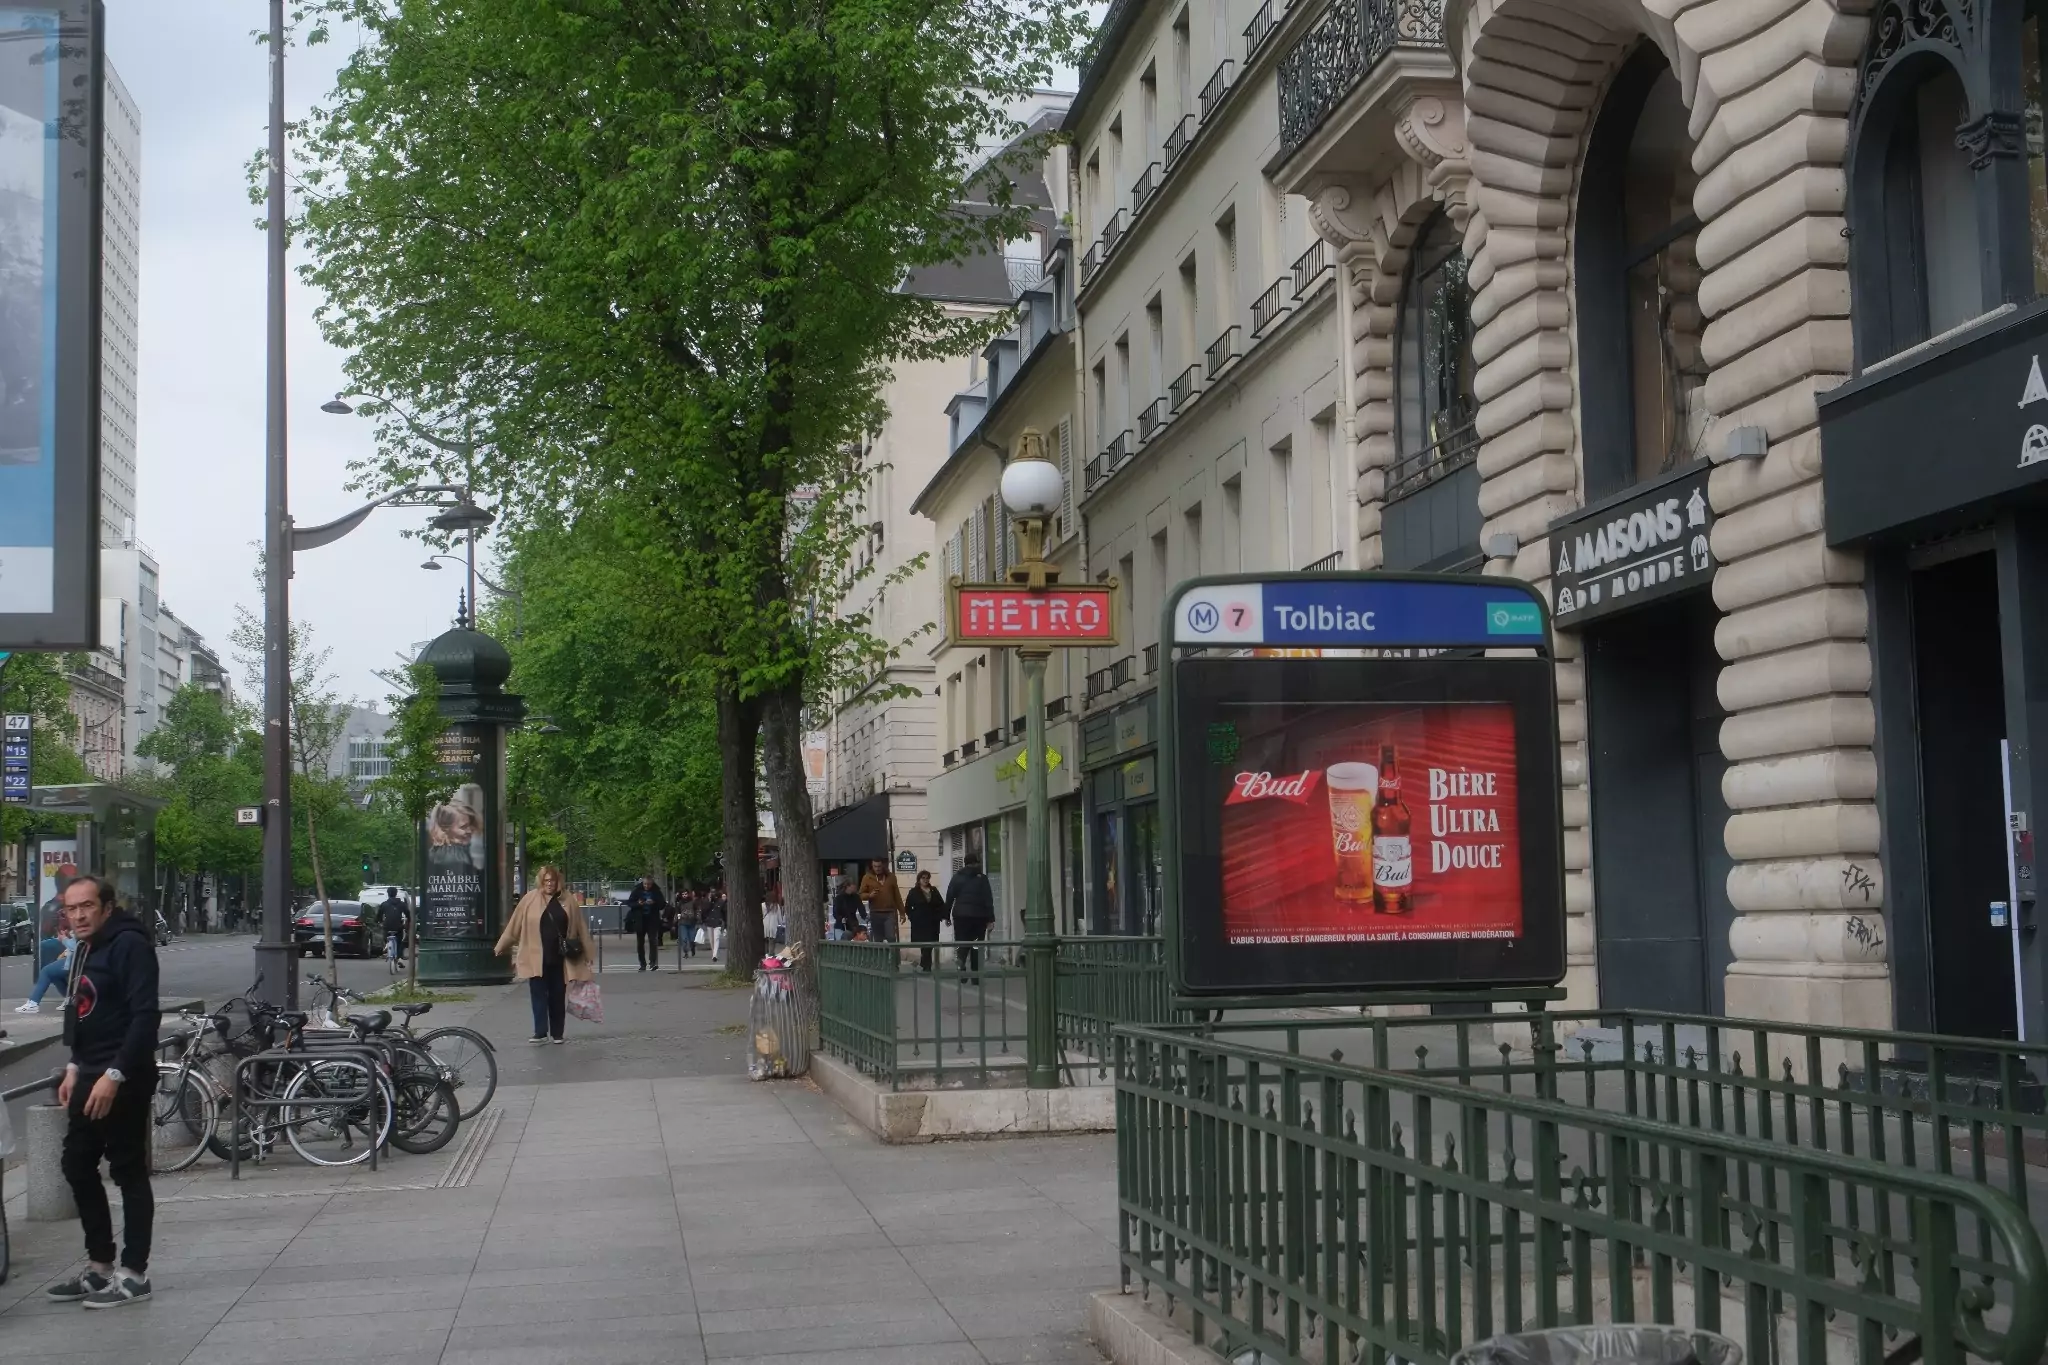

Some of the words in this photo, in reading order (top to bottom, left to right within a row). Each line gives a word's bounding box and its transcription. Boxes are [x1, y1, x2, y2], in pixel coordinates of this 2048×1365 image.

[1575, 498, 1682, 574] MAISONS
[1576, 583, 1601, 609] DU
[1611, 555, 1685, 598] MONDE
[970, 598, 1100, 631] METRO
[1232, 608, 1245, 627] 7
[1273, 605, 1376, 631] Tolbiac
[8, 716, 26, 729] 47
[463, 736, 481, 744] FILM
[1234, 769, 1310, 798] Bud
[242, 811, 253, 820] 55
[1429, 804, 1501, 838] ULTRA
[428, 875, 480, 884] CHAMBRE
[1374, 862, 1410, 882] Bud
[431, 883, 481, 893] MARIANA
[1230, 935, 1255, 944] L'ABUS
[1256, 935, 1290, 944] D'ALCOOL
[1291, 935, 1304, 943] EST
[1305, 934, 1346, 943] DANGEREUX
[1346, 933, 1366, 942] POUR
[1366, 933, 1376, 941] LA
[1408, 931, 1452, 940] CONSOMMER
[1452, 931, 1470, 939] AVEC
[1471, 929, 1515, 939] MODÉRATION
